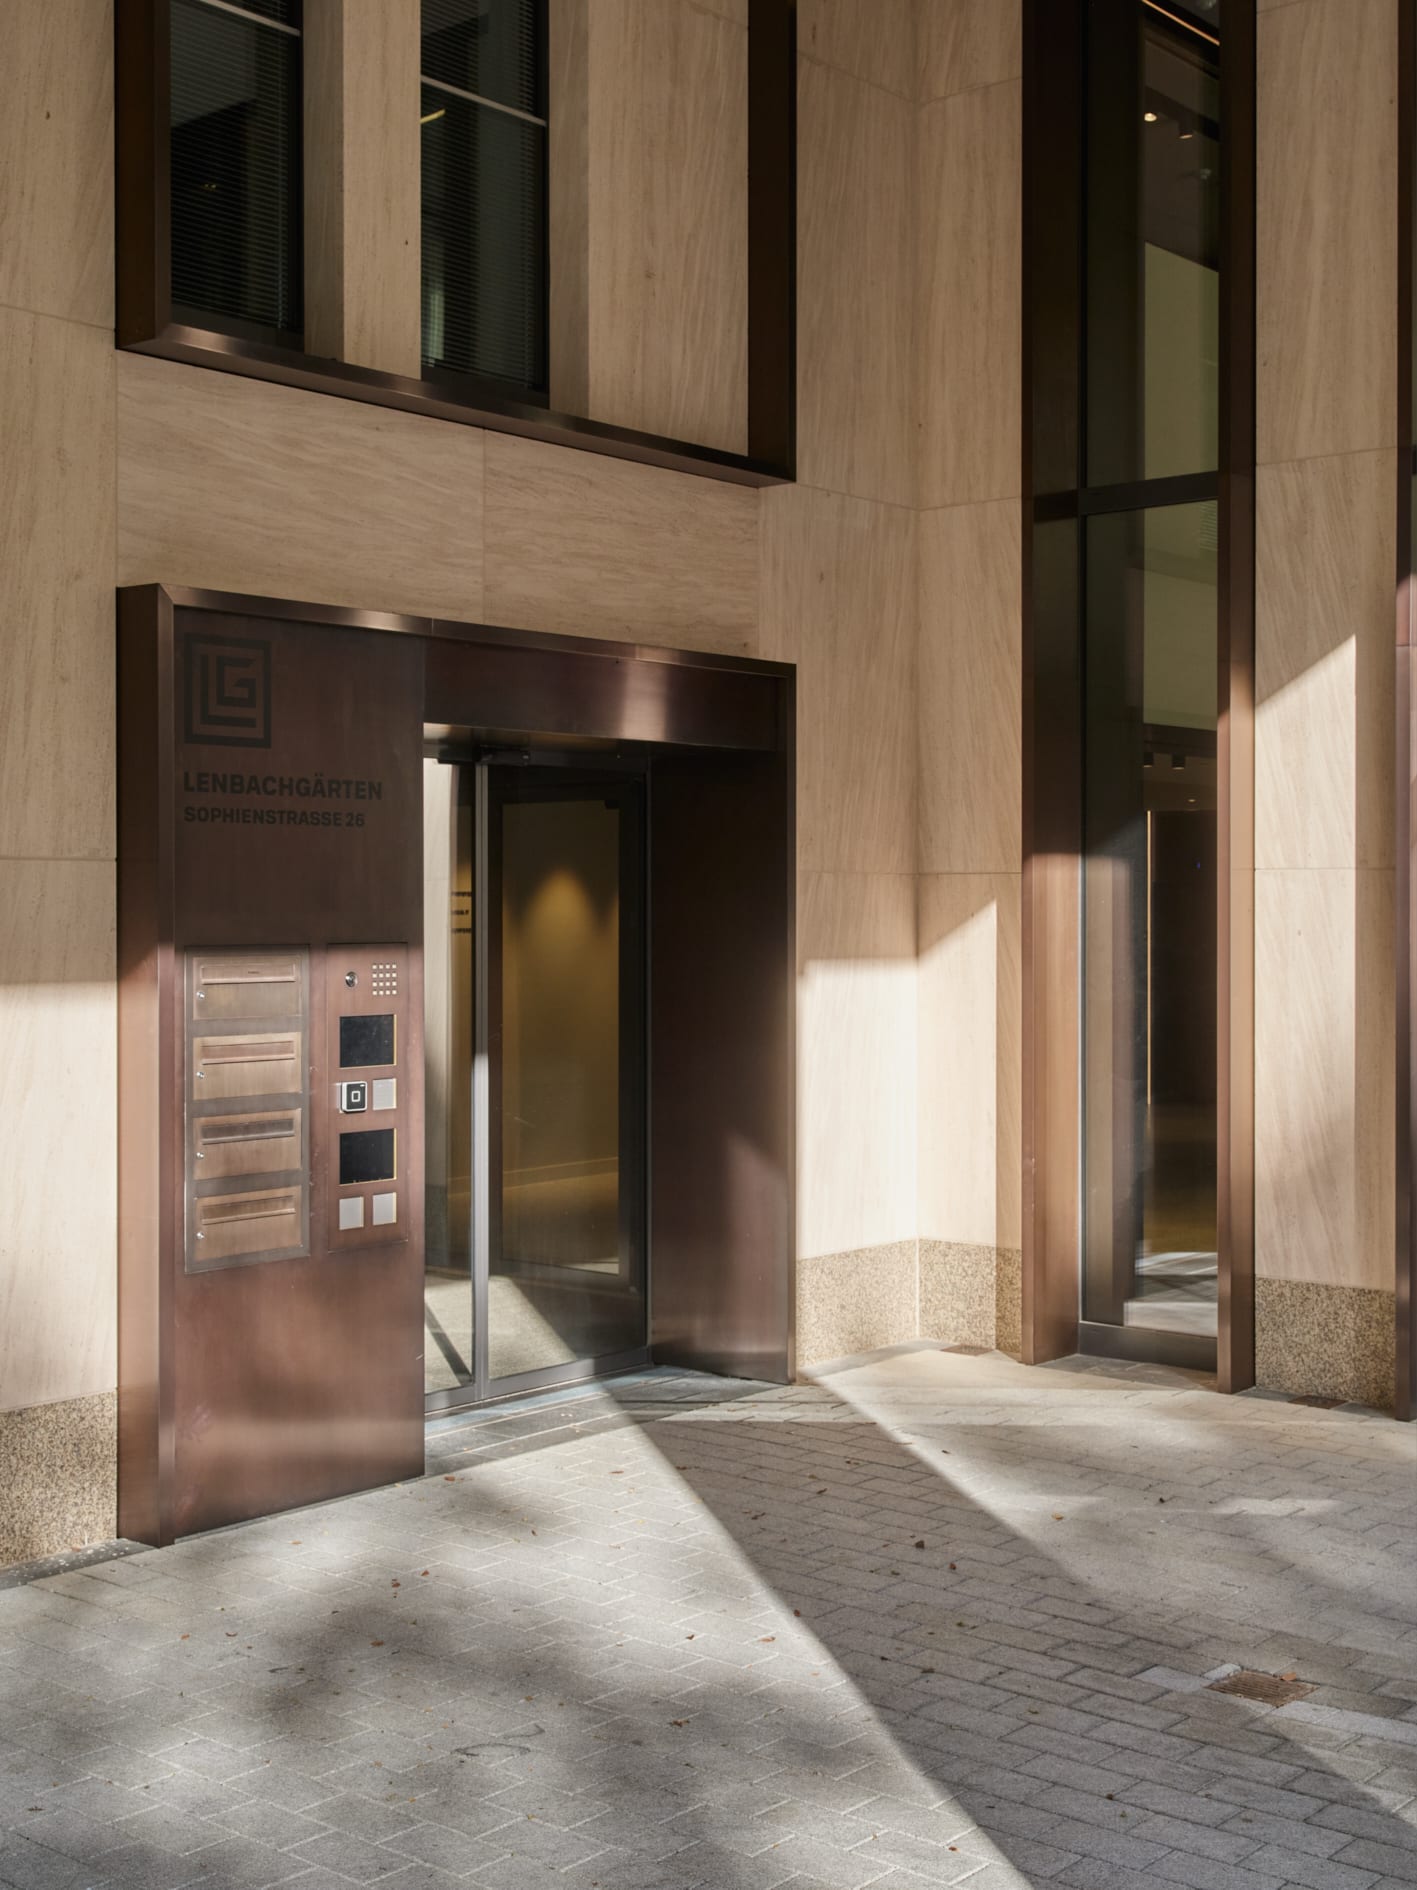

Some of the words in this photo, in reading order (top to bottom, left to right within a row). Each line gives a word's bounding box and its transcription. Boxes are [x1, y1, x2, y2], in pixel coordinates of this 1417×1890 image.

[183, 770, 382, 800] LENBACHGÄRTEN
[183, 805, 342, 827] SOPHIENSTRASSE
[344, 812, 366, 828] 26
